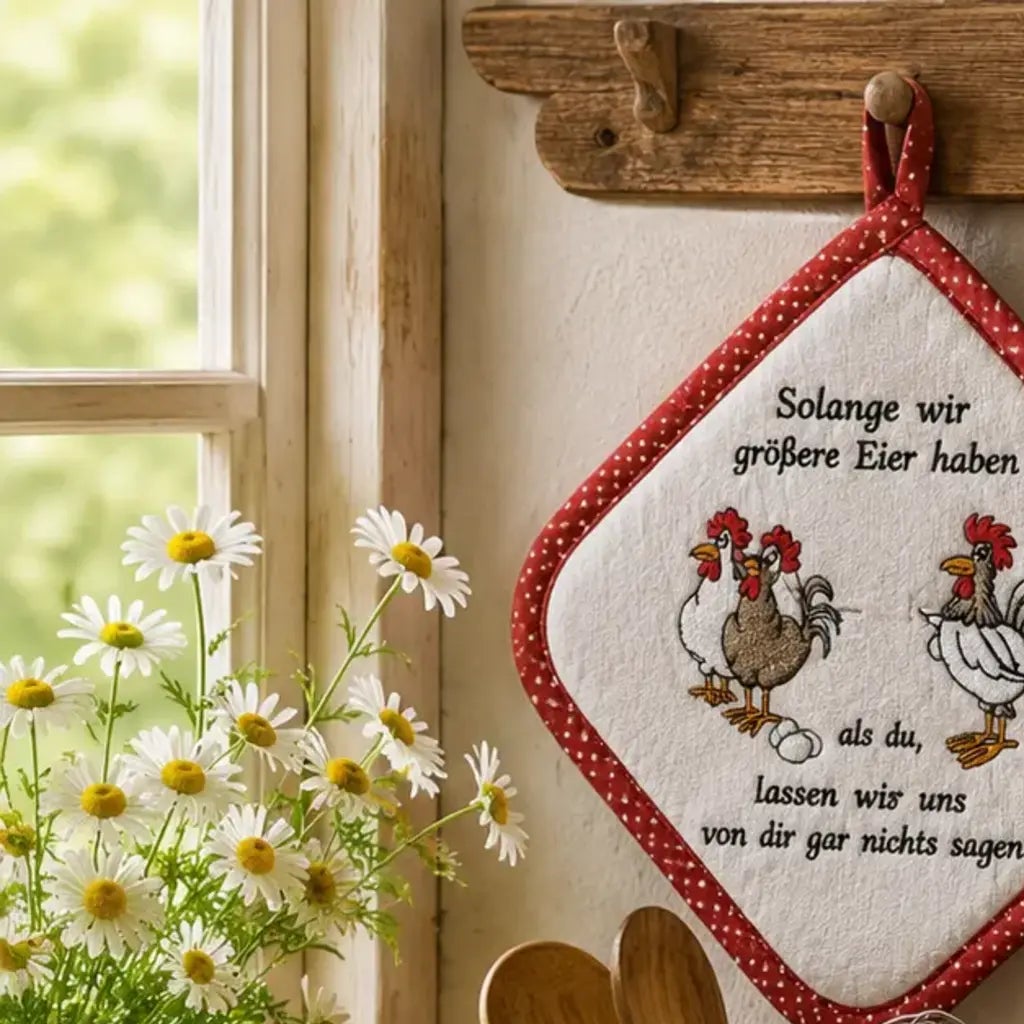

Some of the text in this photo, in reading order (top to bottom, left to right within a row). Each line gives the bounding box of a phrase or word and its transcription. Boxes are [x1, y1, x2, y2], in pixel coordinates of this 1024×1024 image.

[776, 385, 971, 434] Solange wir
[732, 435, 1020, 476] größere Eier haben
[837, 717, 923, 755] als du,
[754, 774, 839, 808] lassen
[919, 792, 967, 814] uns
[701, 826, 748, 848] von
[759, 819, 797, 849] dir
[805, 831, 851, 861] gar
[861, 824, 938, 856] nichts
